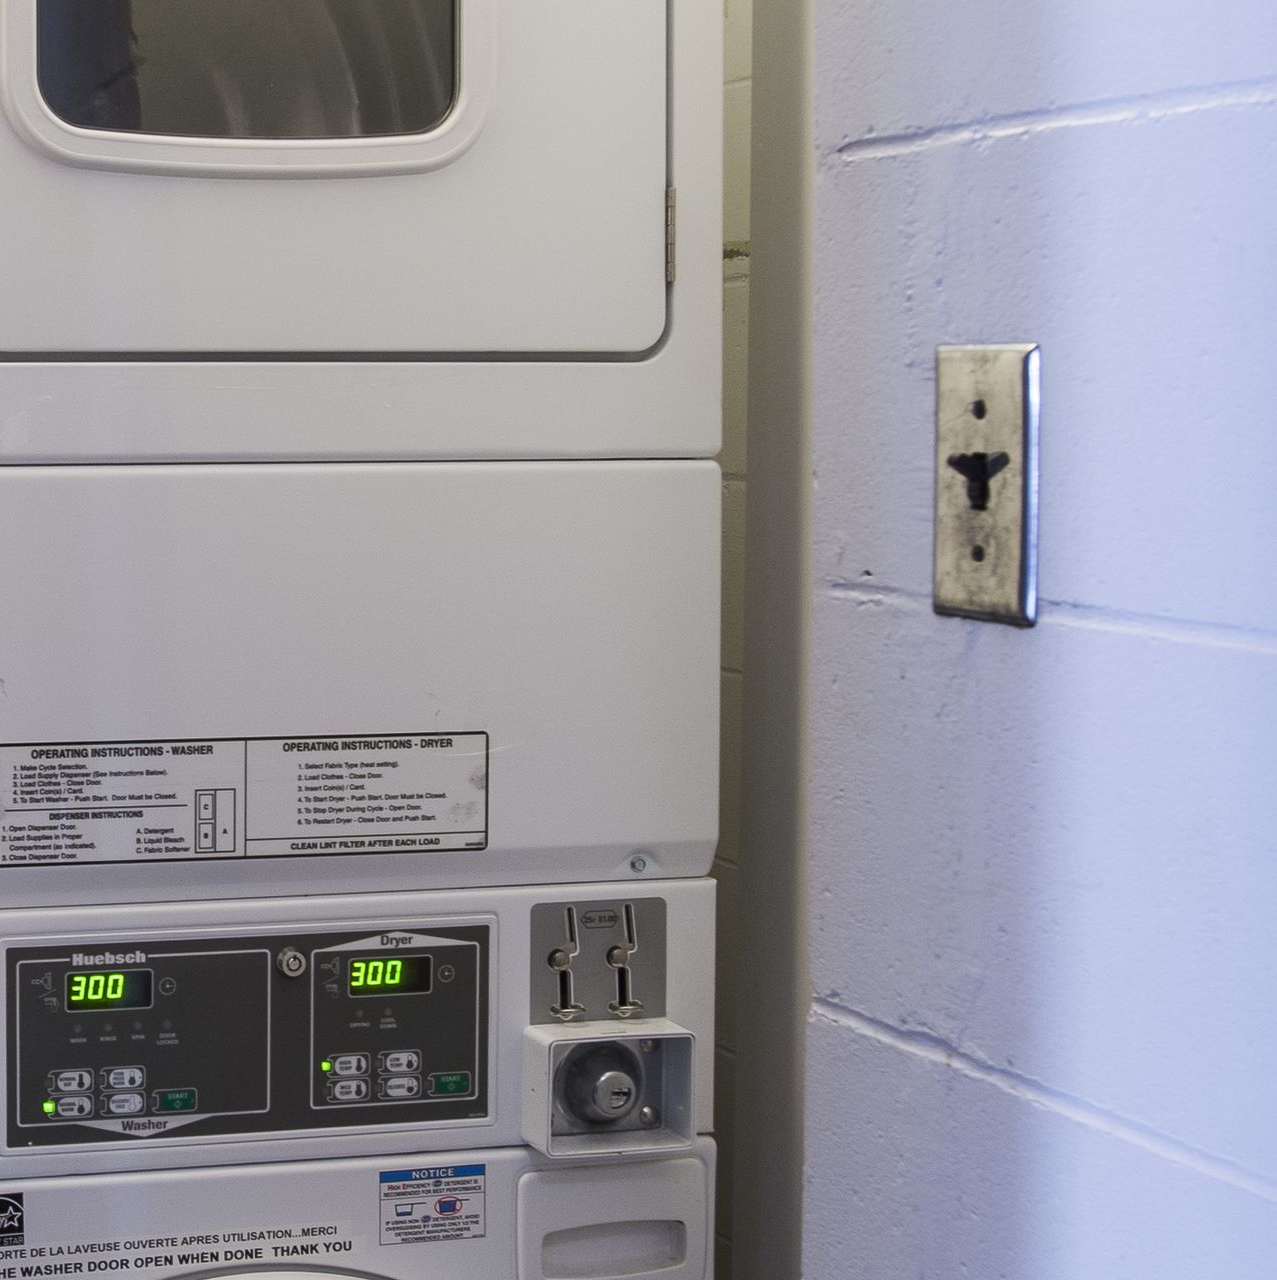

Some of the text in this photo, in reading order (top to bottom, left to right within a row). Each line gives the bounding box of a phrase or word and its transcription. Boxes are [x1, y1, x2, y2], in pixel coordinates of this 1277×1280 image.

[31, 745, 213, 759] OPERATING INSTRUCTIONS WASHER
[283, 739, 452, 752] OPERATING INSTRUCTIONS DRYER
[49, 811, 143, 820] DISPENSER INSTRUCTIONS
[290, 837, 440, 850] CLEAN LINT FILTER AFTER EACH LOAD
[381, 935, 413, 948] Dryer
[72, 950, 146, 966] Huebsch
[351, 960, 402, 986] 300
[70, 974, 124, 1001] 300
[121, 1120, 169, 1132] Washer
[412, 1168, 455, 1179] NOTICE
[4, 1236, 24, 1246] STAR
[30, 1248, 46, 1258] DE
[50, 1246, 64, 1256] LA
[67, 1242, 120, 1254] LAVEUSE
[124, 1238, 178, 1250] OUVERTE
[181, 1234, 220, 1246] APRES
[20, 1262, 83, 1277] WASHER
[88, 1258, 130, 1272] DOOR
[134, 1255, 174, 1268] OPEN
[178, 1251, 219, 1265] WHEN
[224, 1248, 263, 1261] DONE
[272, 1244, 319, 1257] THANK
[323, 1241, 352, 1253] YOU
